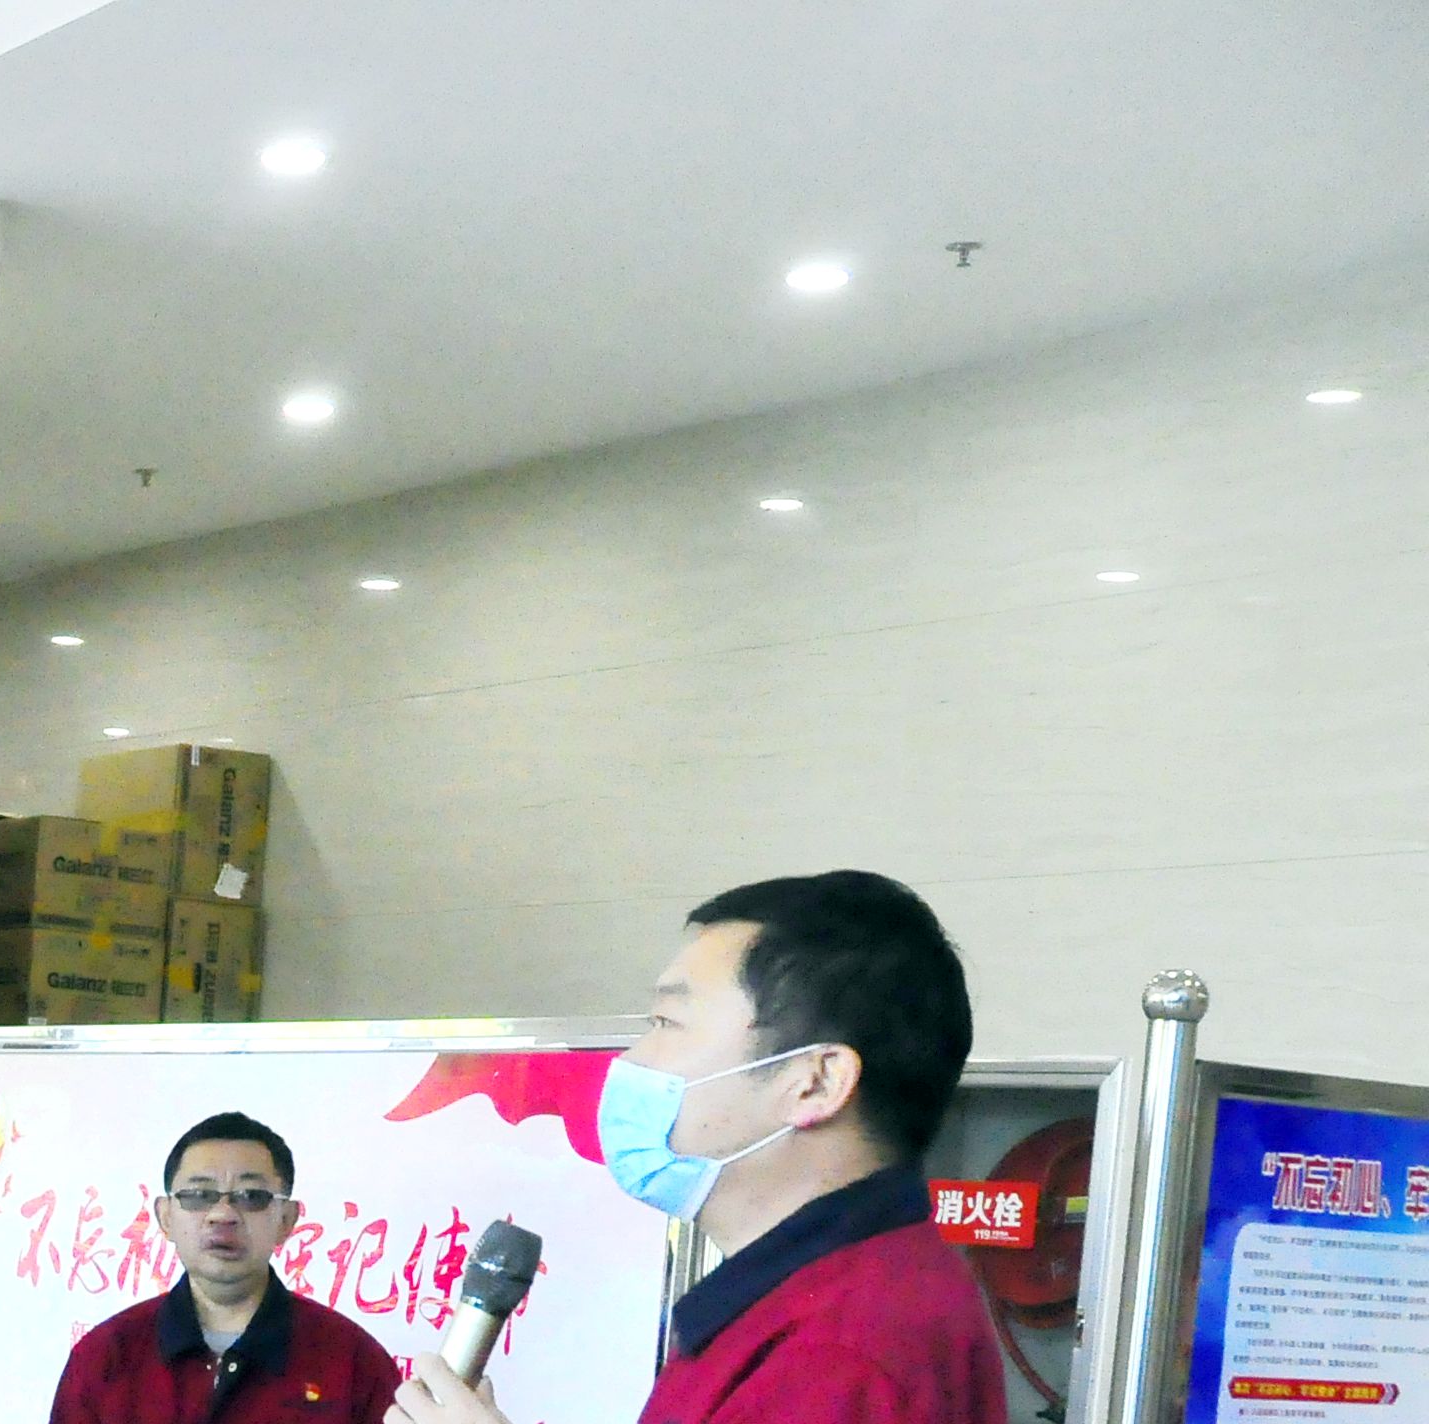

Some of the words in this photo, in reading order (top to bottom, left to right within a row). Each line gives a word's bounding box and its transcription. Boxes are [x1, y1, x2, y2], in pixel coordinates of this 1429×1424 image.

[47, 972, 107, 993] Galanz
[934, 1190, 1024, 1228] 消火栓
